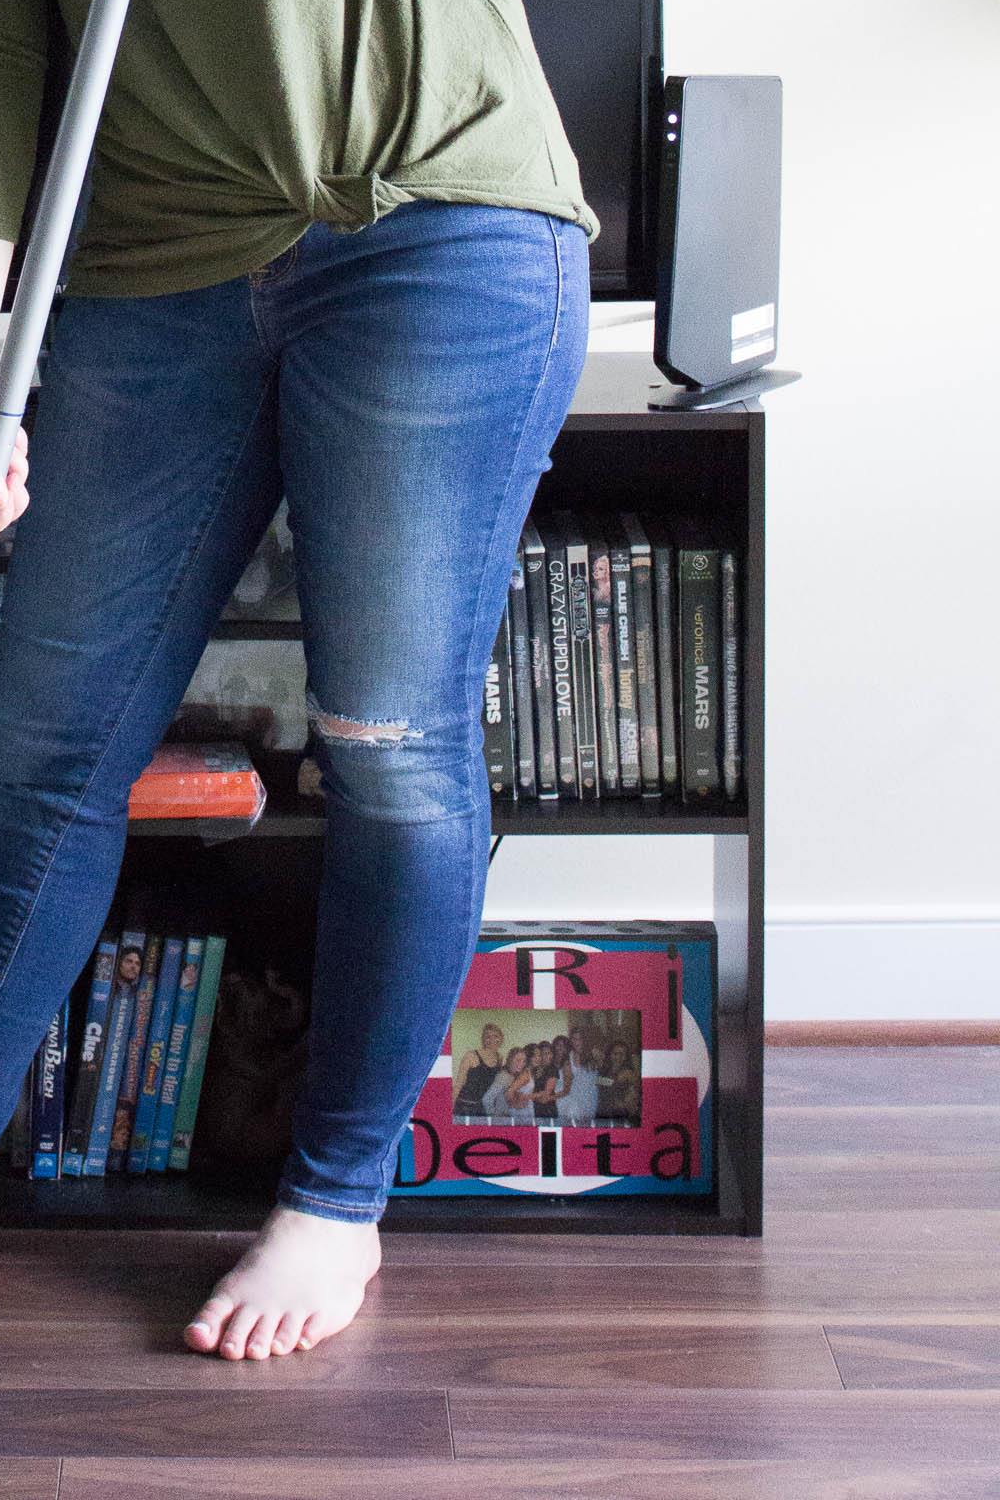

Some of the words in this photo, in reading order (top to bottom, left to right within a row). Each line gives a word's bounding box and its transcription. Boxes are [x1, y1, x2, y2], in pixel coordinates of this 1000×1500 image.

[549, 560, 565, 614] CRAZY
[617, 580, 628, 613] BLUE
[552, 616, 568, 670] STUPID
[619, 616, 630, 661] CRUSH
[694, 605, 705, 665] veronica
[486, 663, 501, 724] MARS
[556, 673, 571, 722] LOVE.
[618, 669, 634, 709] honey
[695, 665, 709, 729] MARS
[626, 718, 638, 764] JOSIE
[82, 1022, 102, 1063] Clue
[149, 1041, 165, 1065] TOY
[169, 1024, 187, 1054] how
[43, 1049, 61, 1099] BEACH
[167, 1057, 181, 1071] to
[143, 1087, 156, 1096] 3
[161, 1075, 180, 1105] deal
[394, 1116, 693, 1189] Delta
